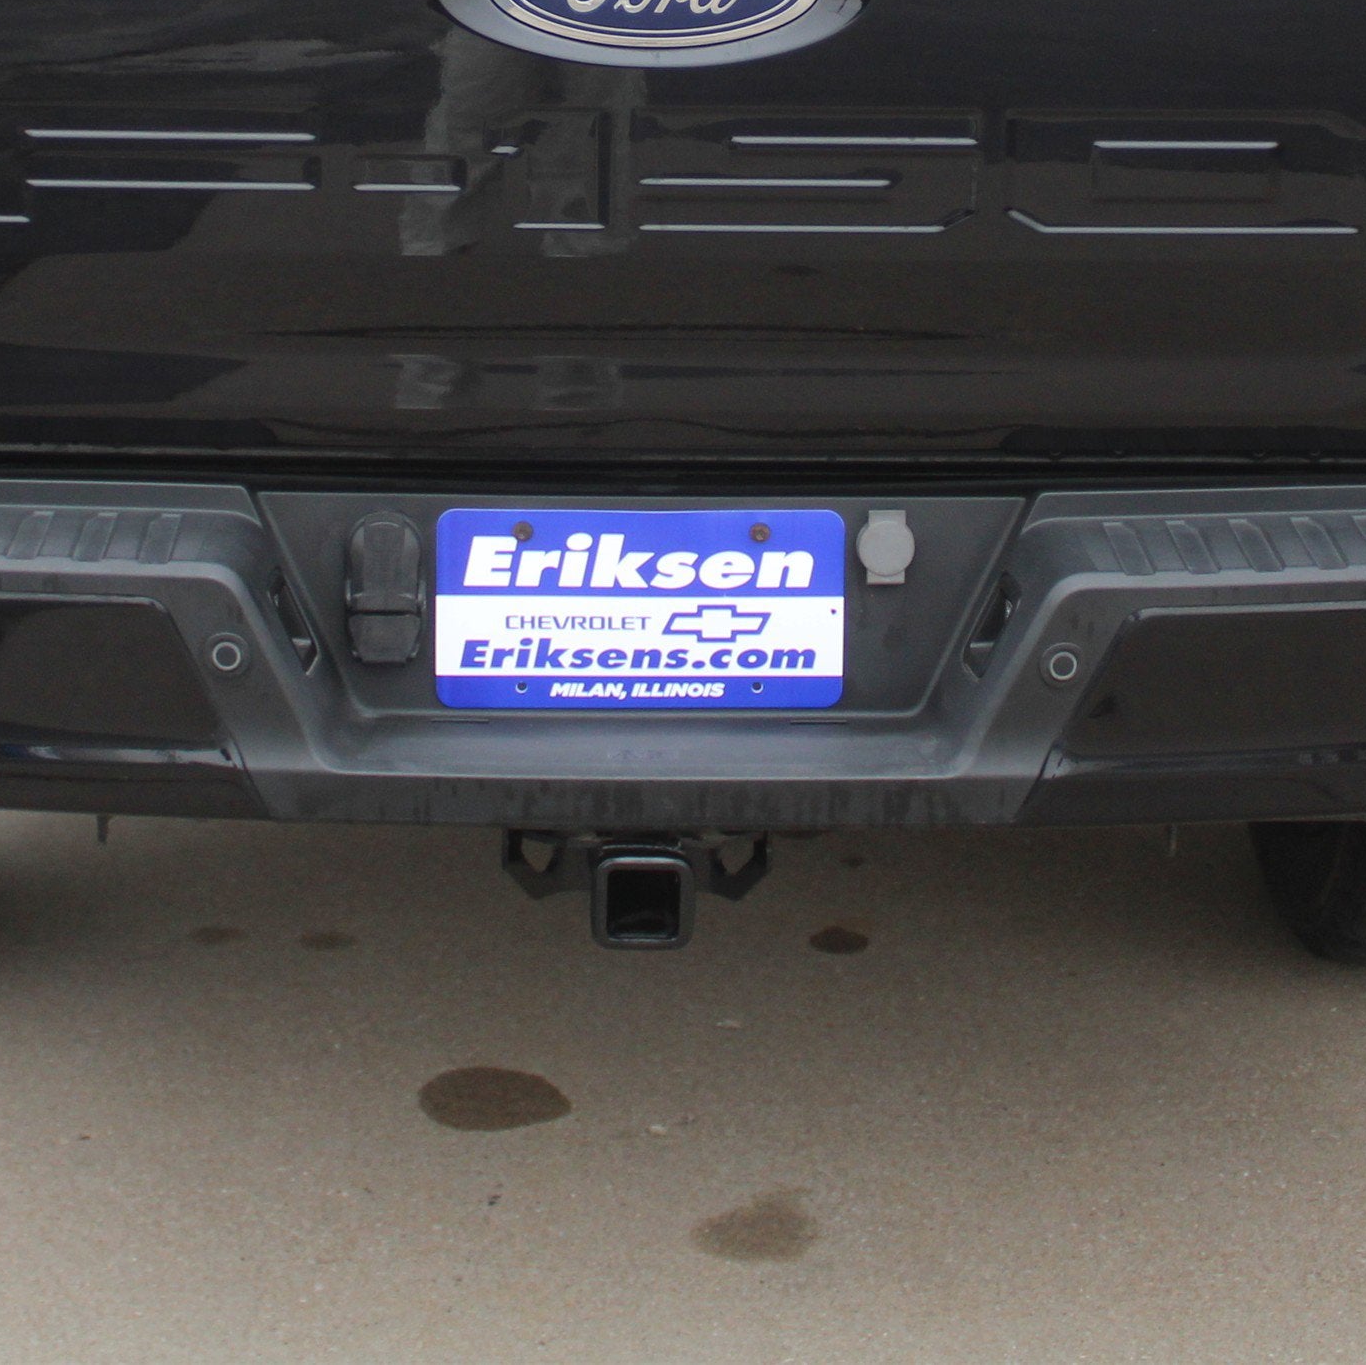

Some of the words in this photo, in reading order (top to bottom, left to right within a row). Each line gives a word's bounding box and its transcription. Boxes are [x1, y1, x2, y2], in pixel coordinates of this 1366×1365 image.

[463, 532, 815, 590] Eriksen
[505, 615, 651, 631] CHEVROLET
[459, 637, 817, 669] Eriksens.com
[550, 682, 627, 700] MILAN,
[629, 682, 725, 698] ILLINOIS
